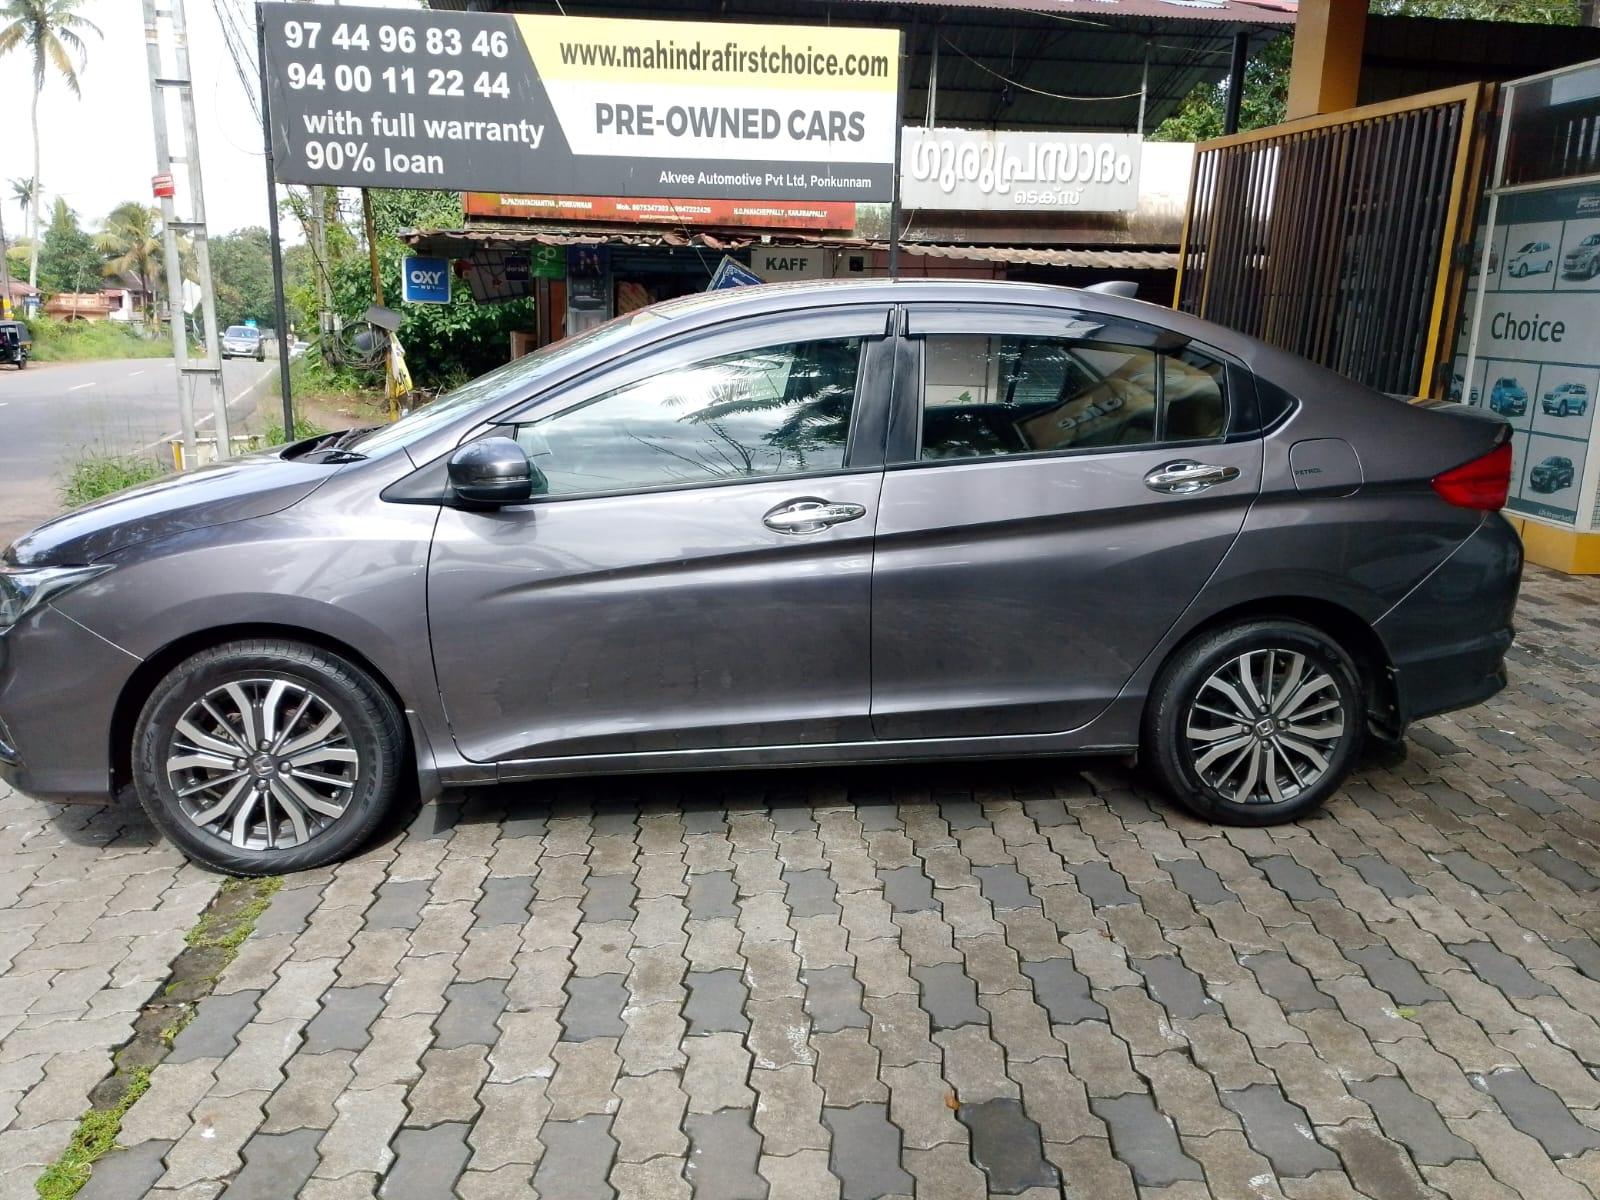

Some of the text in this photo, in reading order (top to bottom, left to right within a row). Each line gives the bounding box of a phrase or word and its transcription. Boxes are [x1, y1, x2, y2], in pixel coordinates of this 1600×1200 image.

[284, 21, 508, 58] 97 44 96 83 46
[560, 39, 888, 77] www.mahindrafirstchoice.com
[287, 63, 510, 98] 94 00 11 22 44
[303, 110, 545, 149] with full warranty
[595, 103, 865, 142] PRE-OWNED CARS
[305, 141, 444, 174] 90% loan
[659, 170, 872, 188] Akvee Automotive Pvt Ltd, Ponkunnam
[410, 270, 441, 285] OXY
[766, 256, 808, 271] KAFF
[1491, 312, 1565, 343] Choice
